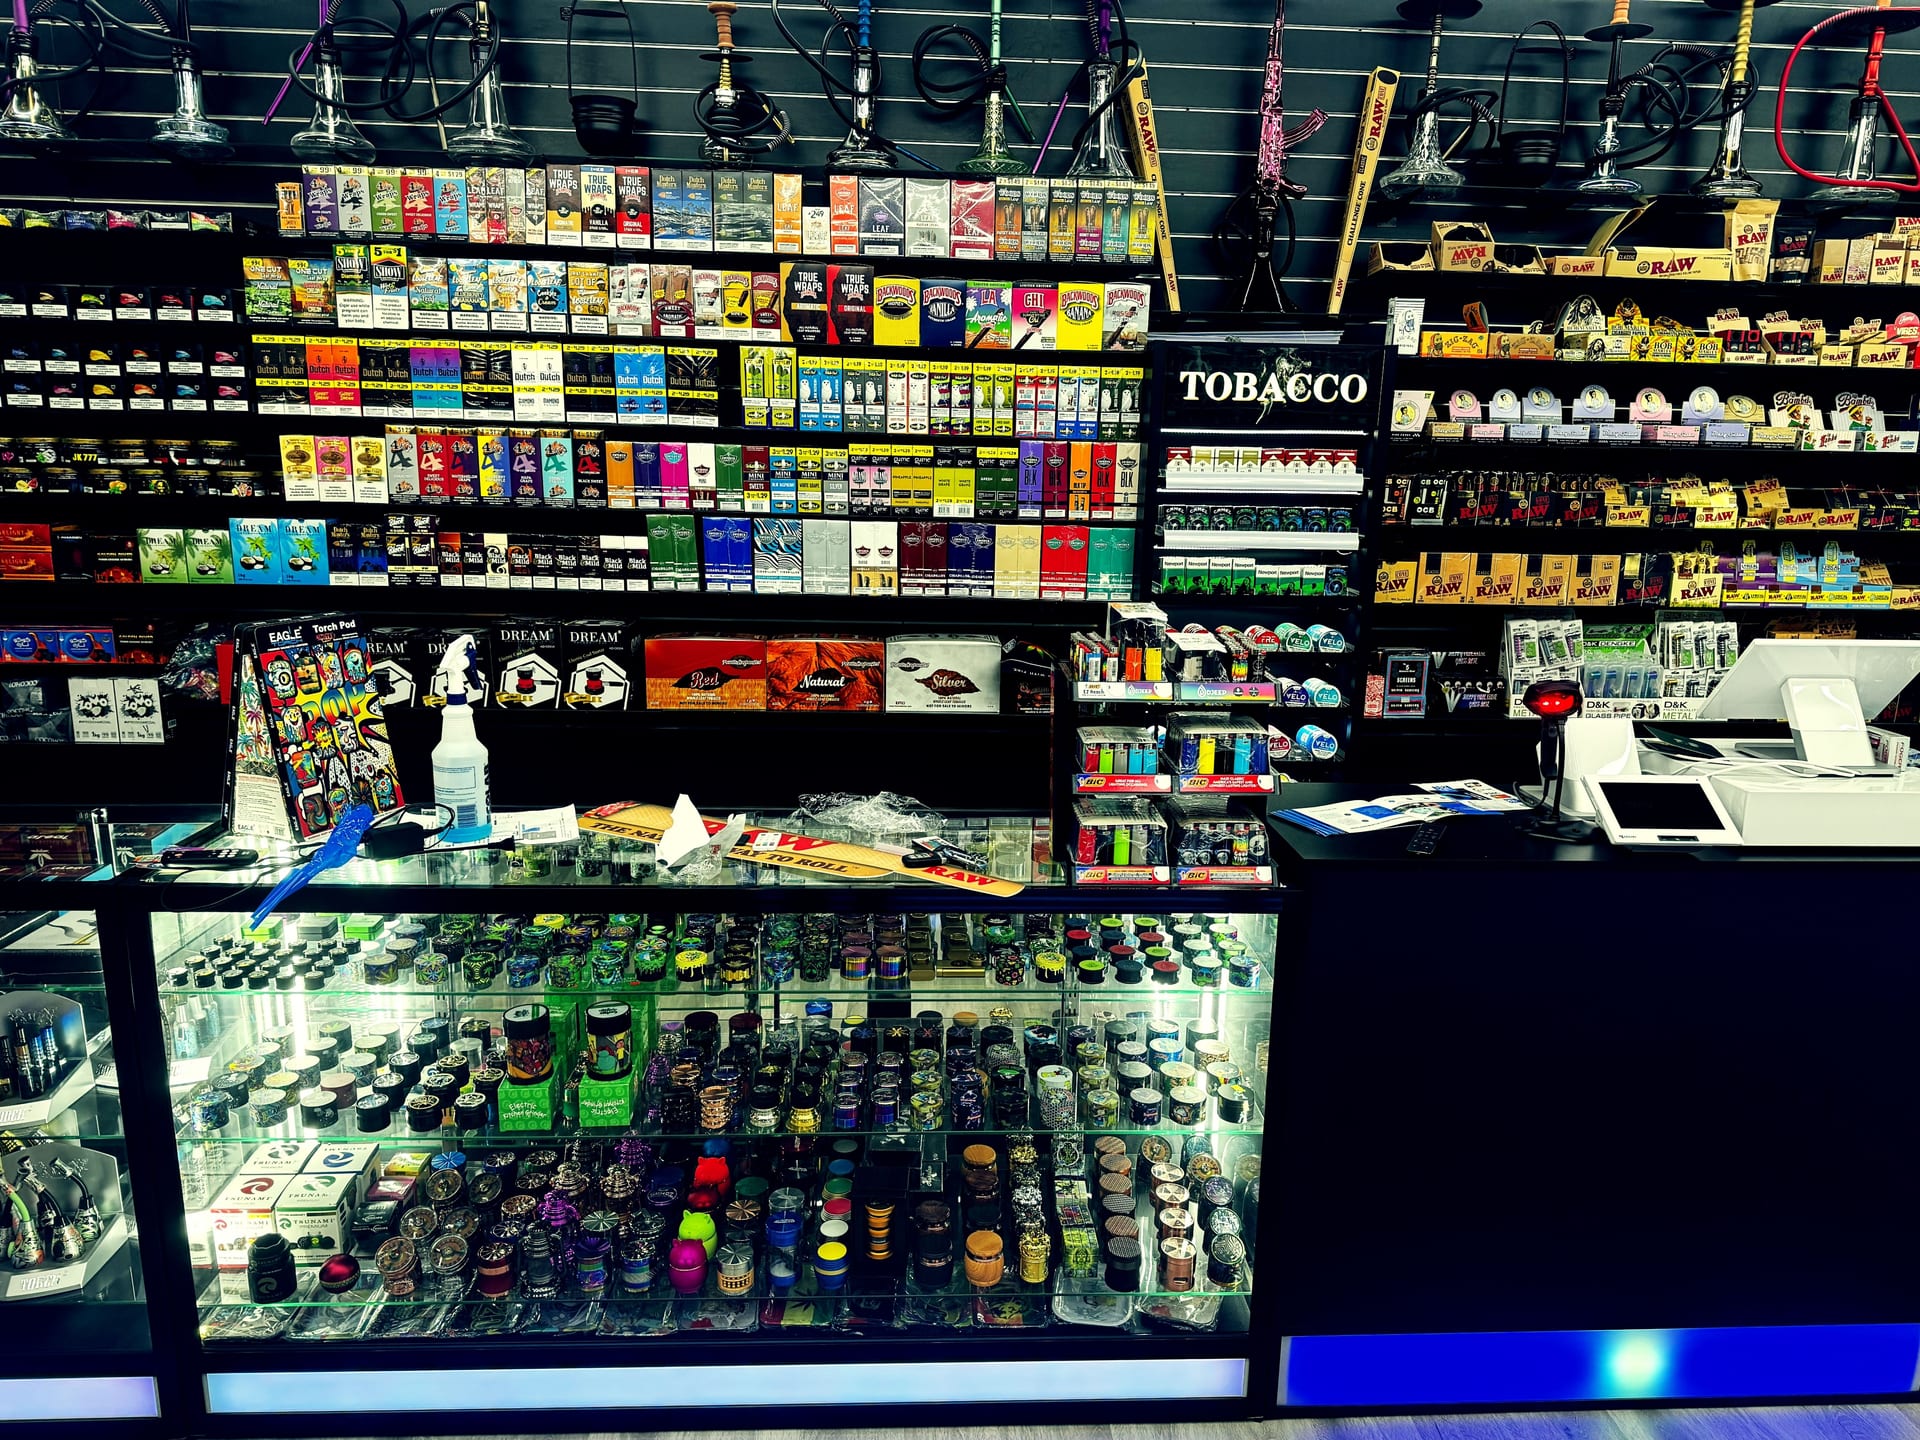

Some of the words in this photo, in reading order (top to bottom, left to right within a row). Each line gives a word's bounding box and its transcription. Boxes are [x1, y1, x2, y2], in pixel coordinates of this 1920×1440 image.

[1371, 99, 1386, 138] RAW
[1138, 116, 1156, 153] RAW
[553, 170, 572, 179] TRUE
[589, 174, 608, 184] TRUE
[549, 179, 578, 189] WRAPS
[622, 176, 642, 186] TRUE
[584, 184, 612, 194] WRAPS
[619, 185, 646, 195] WRAPS
[1347, 200, 1362, 246] CHALLENGE
[1356, 180, 1366, 200] CONE
[873, 225, 889, 233] LEAF
[1158, 220, 1168, 240] CONE
[1737, 232, 1770, 246] RAW
[336, 247, 344, 256] 5
[374, 247, 382, 256] 5
[1618, 253, 1635, 261] CLASSIC
[1875, 256, 1902, 266] RAW
[336, 256, 367, 270] SHOW
[1572, 262, 1595, 272] RAW
[1650, 257, 1698, 275] RAW
[374, 266, 404, 279] SHOW
[798, 272, 818, 282] TRUE
[845, 274, 864, 285] TRUE
[1167, 273, 1176, 292] RAW
[794, 282, 822, 292] WRAPS
[841, 283, 869, 294] WRAPS
[1335, 278, 1343, 298] RAW
[877, 286, 916, 304] BACKWOODS
[923, 286, 962, 306] BACKWOODS
[980, 289, 997, 306] LA
[1024, 293, 1044, 307] CHI
[1060, 289, 1100, 308] BACKWOODS
[1108, 290, 1146, 307] BACKWOODS
[929, 302, 957, 317] VANILLA
[1066, 308, 1095, 319] BANANA
[1654, 342, 1672, 352] BOB
[1699, 343, 1718, 352] BOB
[1828, 352, 1849, 361] RAW
[1870, 350, 1899, 362] RAW
[257, 365, 278, 374] Dutch
[283, 366, 304, 374] Dutch
[309, 365, 330, 374] Dutch
[335, 366, 356, 375] Dutch
[363, 368, 383, 378] Dutch
[388, 369, 408, 378] Dutch
[413, 368, 434, 377] Dutch
[437, 368, 458, 377] Dutch
[514, 372, 535, 381] Dutch
[540, 373, 560, 381] Dutch
[566, 374, 587, 383] Dutch
[591, 374, 612, 383] Dutch
[618, 376, 638, 385] Dutch
[643, 376, 663, 385] Dutch
[670, 377, 690, 386] Dutch
[1180, 371, 1368, 404] TOBACCO
[748, 472, 765, 480] MINI
[775, 470, 791, 478] MINI
[828, 472, 843, 480] MINI
[1024, 470, 1037, 486] BLK
[1048, 470, 1062, 487] BLK
[1097, 470, 1109, 487] BLK
[1120, 471, 1133, 487] BLK
[1416, 506, 1434, 514] OCB
[1460, 503, 1498, 519] RAW
[1512, 504, 1549, 519] RAW
[1617, 511, 1643, 521] RAW
[1705, 511, 1735, 523] RAW
[1785, 513, 1815, 524] RAW
[1826, 513, 1855, 524] RAW
[236, 524, 272, 534] DREAM
[284, 524, 320, 534] DREAM
[192, 538, 222, 546] DREAM
[1425, 581, 1462, 597] RAW
[1476, 582, 1513, 597] RAW
[1526, 584, 1563, 599] RAW
[1576, 585, 1612, 599] RAW
[1680, 586, 1715, 600] RAW
[312, 621, 337, 633] Torch
[339, 620, 356, 630] Pod
[268, 630, 302, 643] EAGLE
[500, 630, 550, 642] DREAM
[570, 631, 618, 643] DREAM
[1290, 638, 1310, 646] VELO
[1321, 639, 1342, 647] VELO
[366, 642, 405, 653] REAM
[691, 671, 720, 688] Red
[800, 674, 846, 689] Natural
[931, 674, 967, 689] Silver
[1285, 693, 1306, 702] VELO
[1317, 692, 1337, 701] VELO
[1586, 700, 1610, 710] D&K
[1663, 701, 1688, 710] D&K
[1662, 712, 1693, 720] METAL
[1270, 741, 1288, 750] VELO
[1315, 741, 1335, 749] VELO
[590, 821, 630, 837] THE
[763, 851, 784, 863] TO
[786, 856, 849, 873] ROLL
[923, 865, 998, 887] RAW
